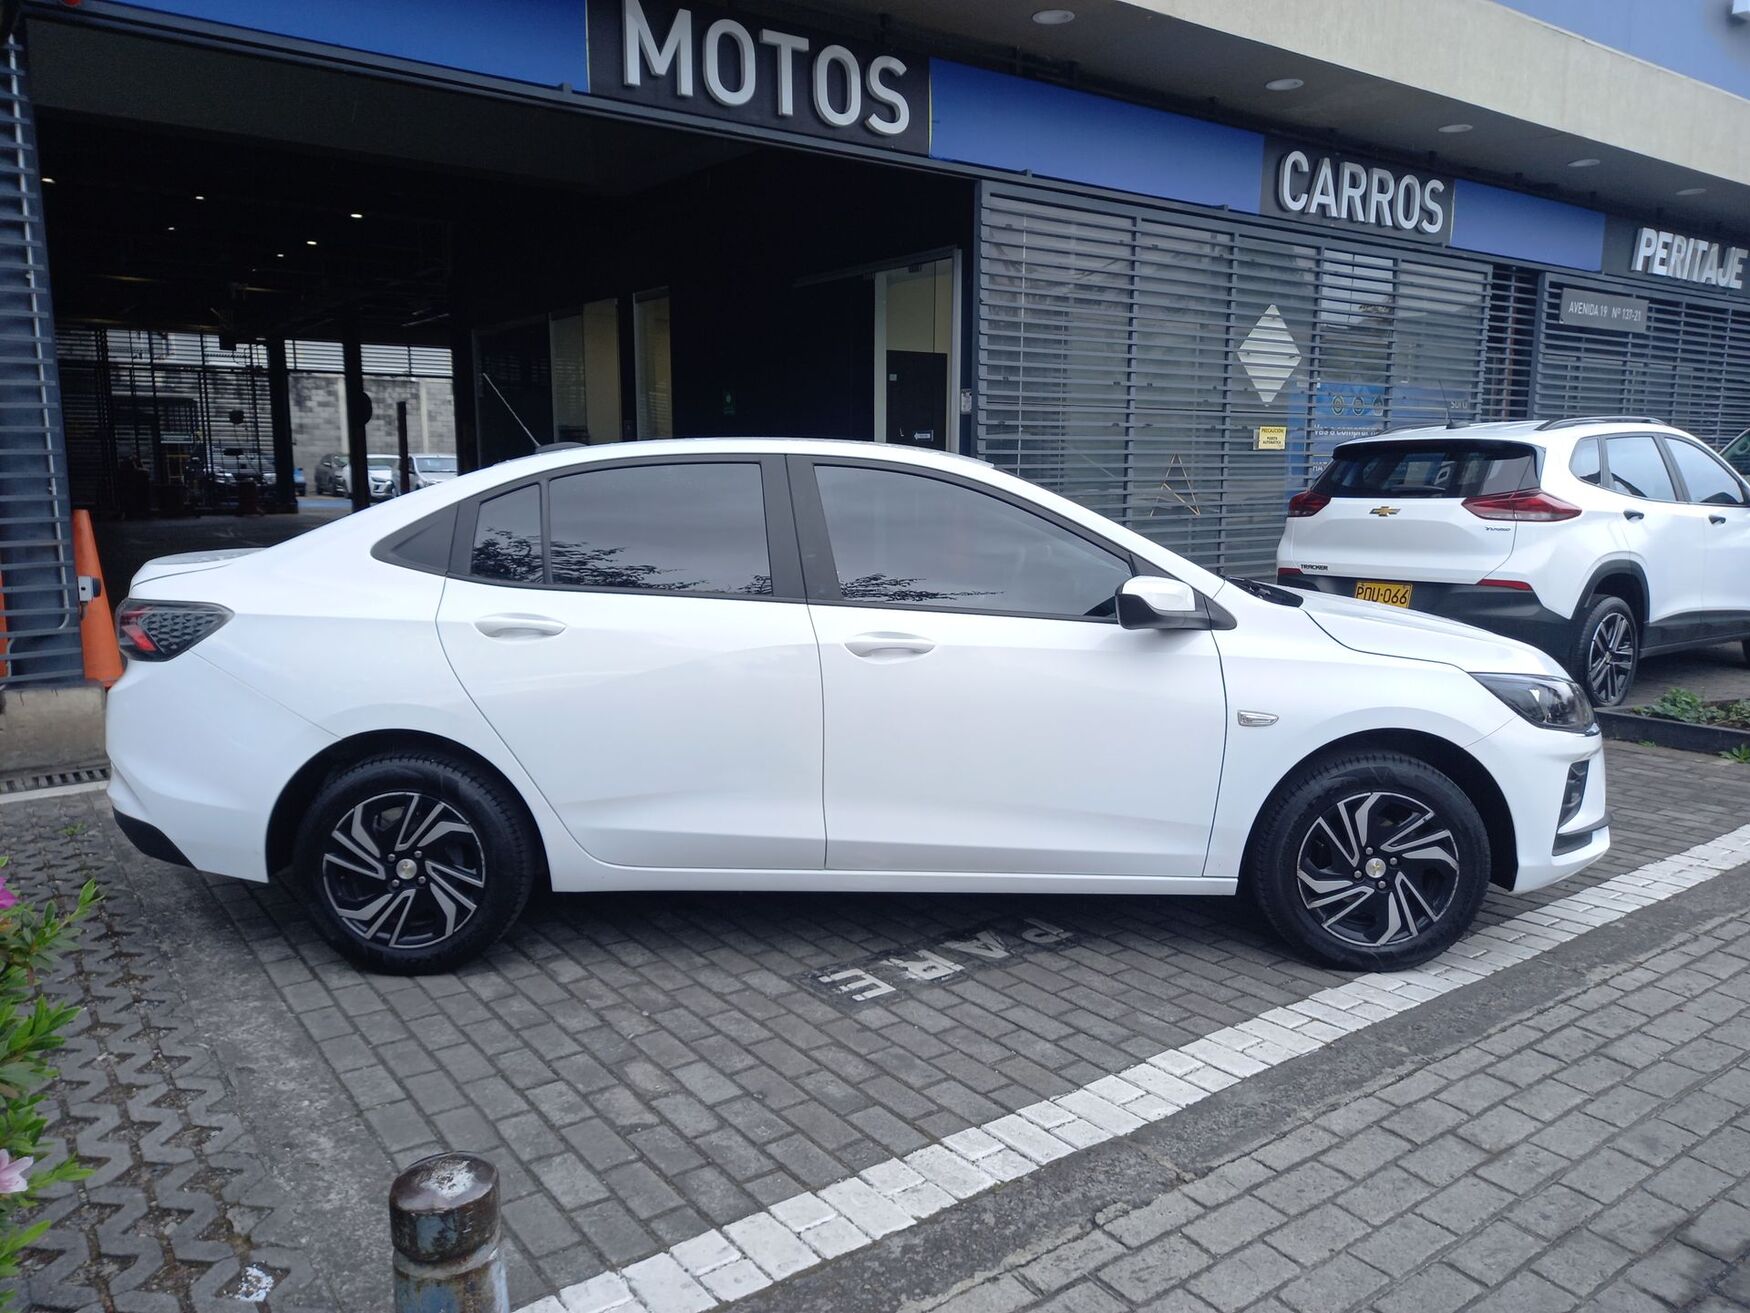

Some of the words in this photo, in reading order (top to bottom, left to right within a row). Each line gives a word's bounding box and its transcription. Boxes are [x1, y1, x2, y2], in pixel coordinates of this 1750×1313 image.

[622, 0, 910, 136] MOTOS
[1278, 150, 1445, 234] CARROS
[1631, 227, 1749, 290] PERITAJE
[1568, 301, 1599, 317] AVENIDA
[1600, 305, 1608, 318] 19
[1300, 563, 1329, 571] TRACKER
[818, 917, 1074, 1001] PARE
